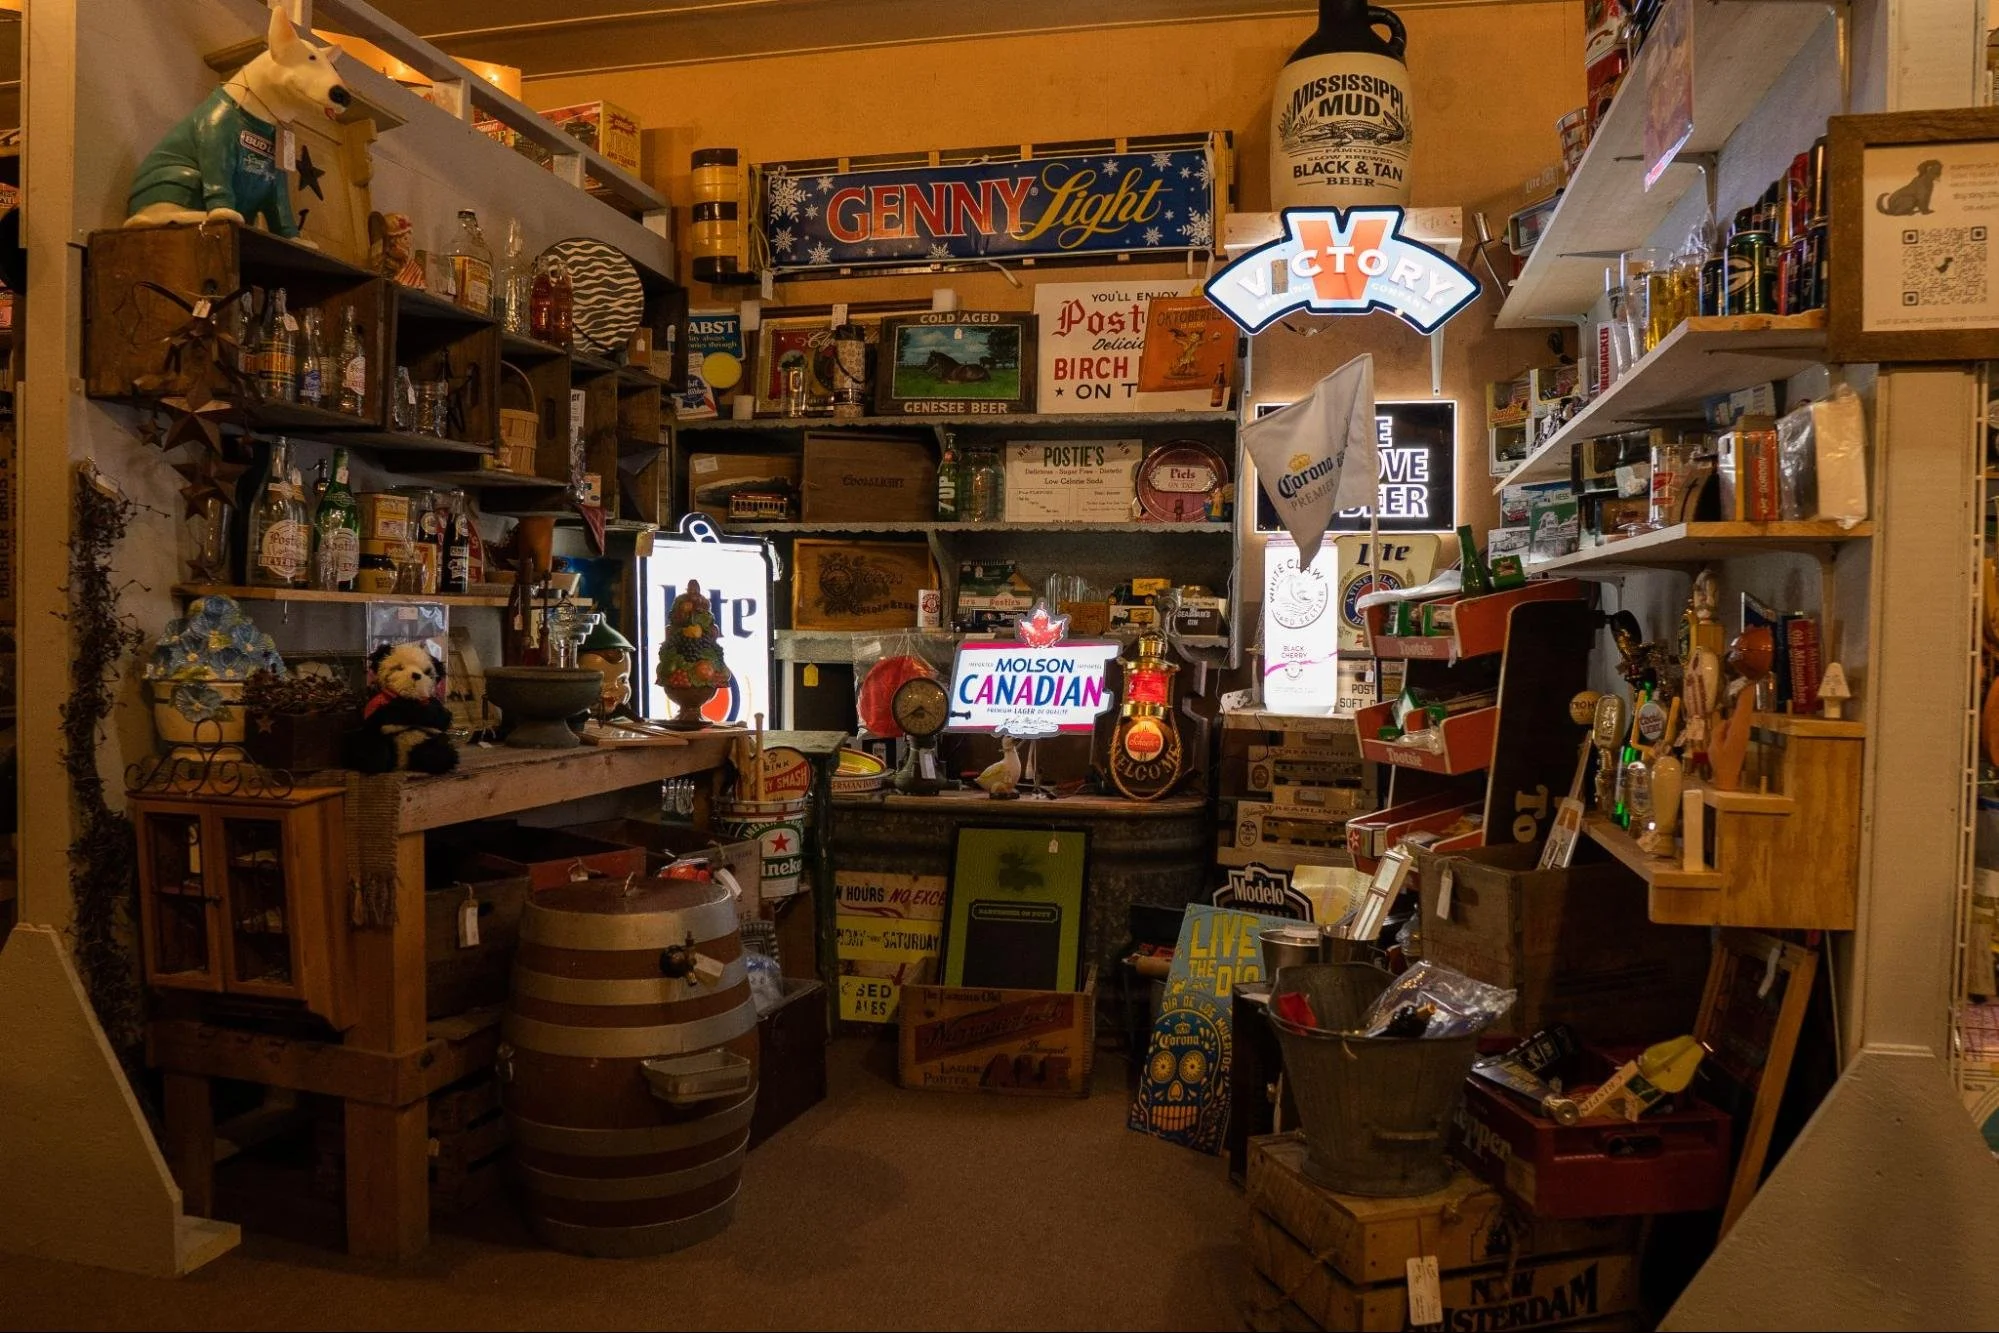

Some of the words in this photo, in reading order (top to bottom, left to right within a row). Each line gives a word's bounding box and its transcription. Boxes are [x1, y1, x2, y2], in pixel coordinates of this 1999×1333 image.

[1292, 74, 1404, 121] MISSISSIPPI
[1318, 94, 1380, 117] MUD
[1325, 147, 1379, 155] FAMOUS
[1345, 155, 1393, 164] BREWED
[1293, 161, 1350, 179] BLACK
[1354, 161, 1369, 175] &
[1373, 162, 1403, 182] TAN
[1325, 177, 1376, 187] BEER
[826, 175, 1037, 244] GENNY
[1010, 162, 1174, 250] Light
[1236, 245, 1455, 304] VICTORY
[1091, 290, 1131, 303] YOU'LL
[687, 320, 737, 335] ABST
[920, 313, 955, 324] COLD
[961, 313, 1000, 323] AGED
[1052, 299, 1144, 337] Post
[1092, 338, 1145, 351] Delici
[1054, 356, 1129, 381] BIRCH
[1599, 327, 1610, 391] IRECRACKER
[1076, 383, 1111, 400] ON
[904, 401, 965, 413] GENESEE
[971, 402, 1008, 414] BEER
[1043, 445, 1105, 468] POSTIE'S
[1044, 478, 1058, 486] Low
[1086, 478, 1104, 486] Soda
[1059, 468, 1077, 477] Sugar
[1278, 457, 1334, 499] Corona
[938, 475, 957, 513] 7UP
[1291, 480, 1335, 511] PREMIER
[1356, 543, 1411, 567] Lte
[657, 584, 758, 639] Lte
[995, 658, 1075, 674] MOLSON
[1281, 652, 1309, 660] CHERRY
[959, 674, 1105, 708] CANADIAN
[1351, 684, 1375, 695] POST
[1339, 698, 1364, 709] SOFT
[763, 760, 790, 772] RINK
[777, 765, 808, 789] SMASH
[760, 857, 803, 878] ineke
[846, 885, 885, 902] HOURS
[888, 888, 913, 904] NO
[1233, 877, 1285, 906] Modelo
[882, 931, 939, 951] SATURDAY
[1190, 912, 1260, 958] LIVE
[1189, 959, 1217, 978] THE
[1157, 1033, 1201, 1050] Corona
